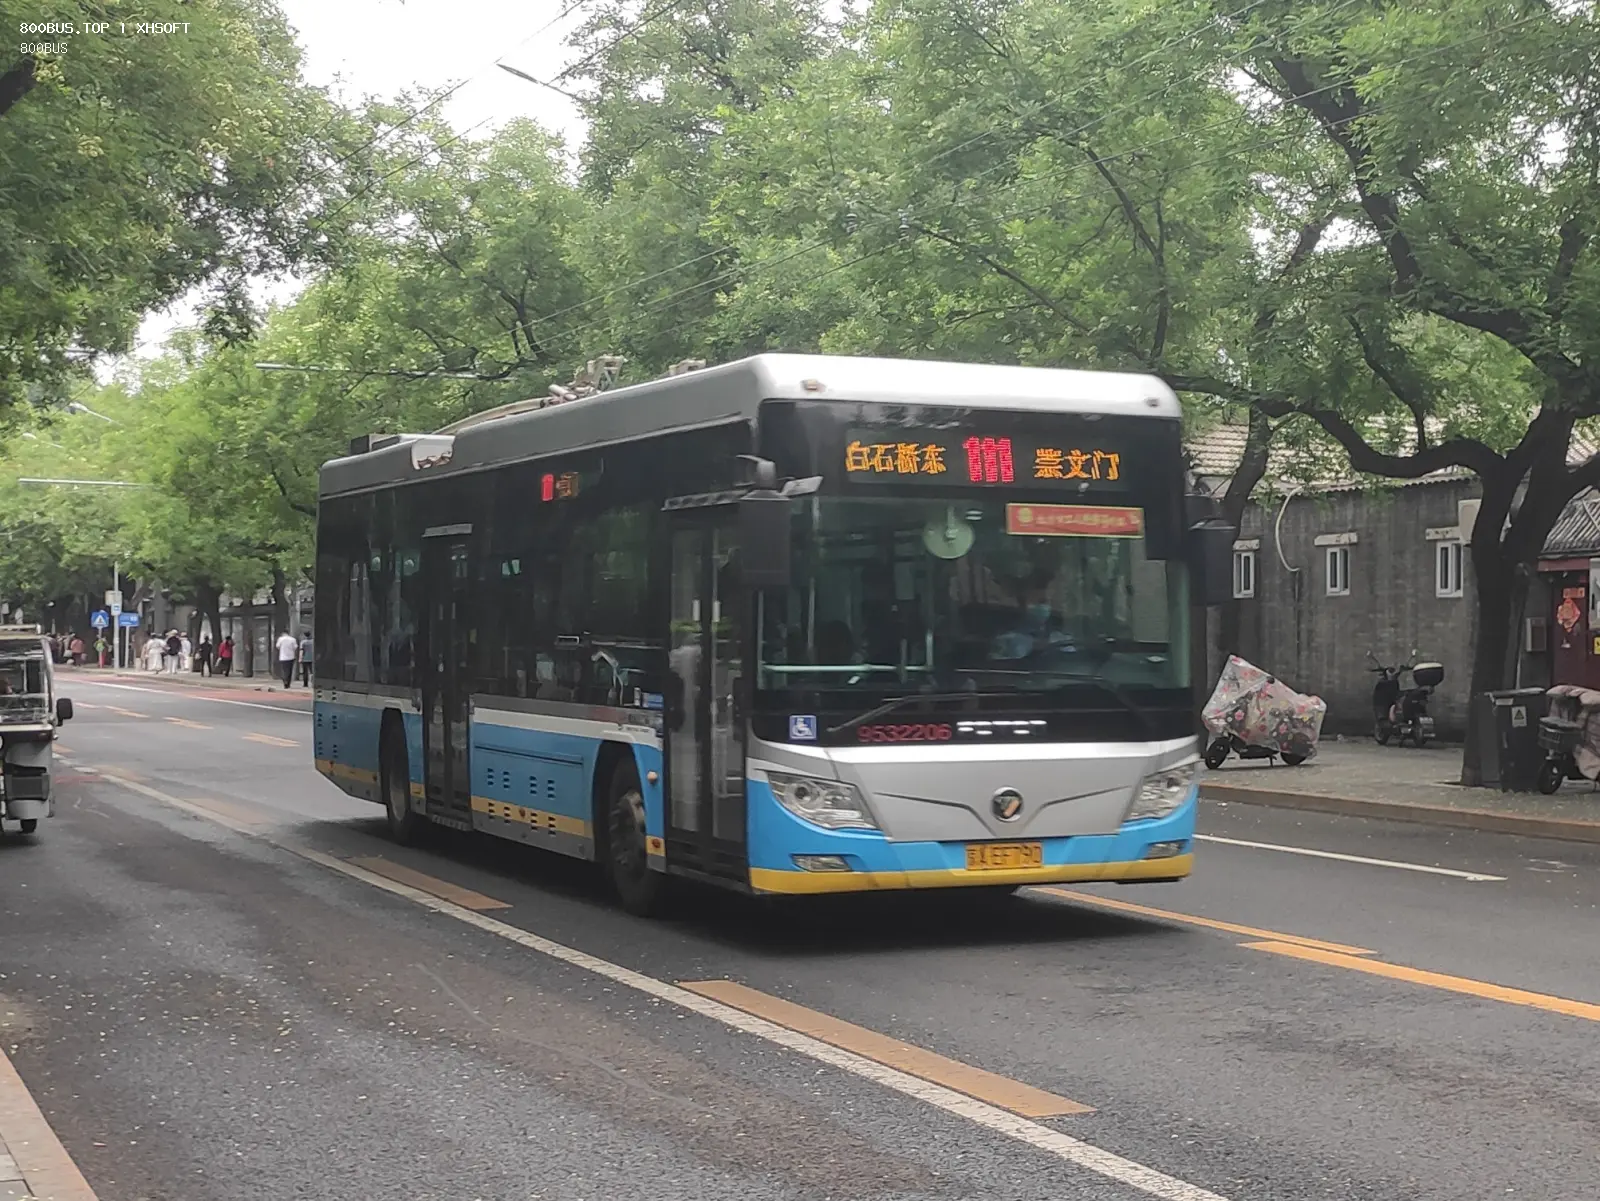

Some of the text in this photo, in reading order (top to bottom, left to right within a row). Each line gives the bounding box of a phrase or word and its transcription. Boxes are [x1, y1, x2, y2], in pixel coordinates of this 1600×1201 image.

[845, 435, 1121, 484] 白石桥东 111 崇文门
[857, 722, 953, 743] 9532206
